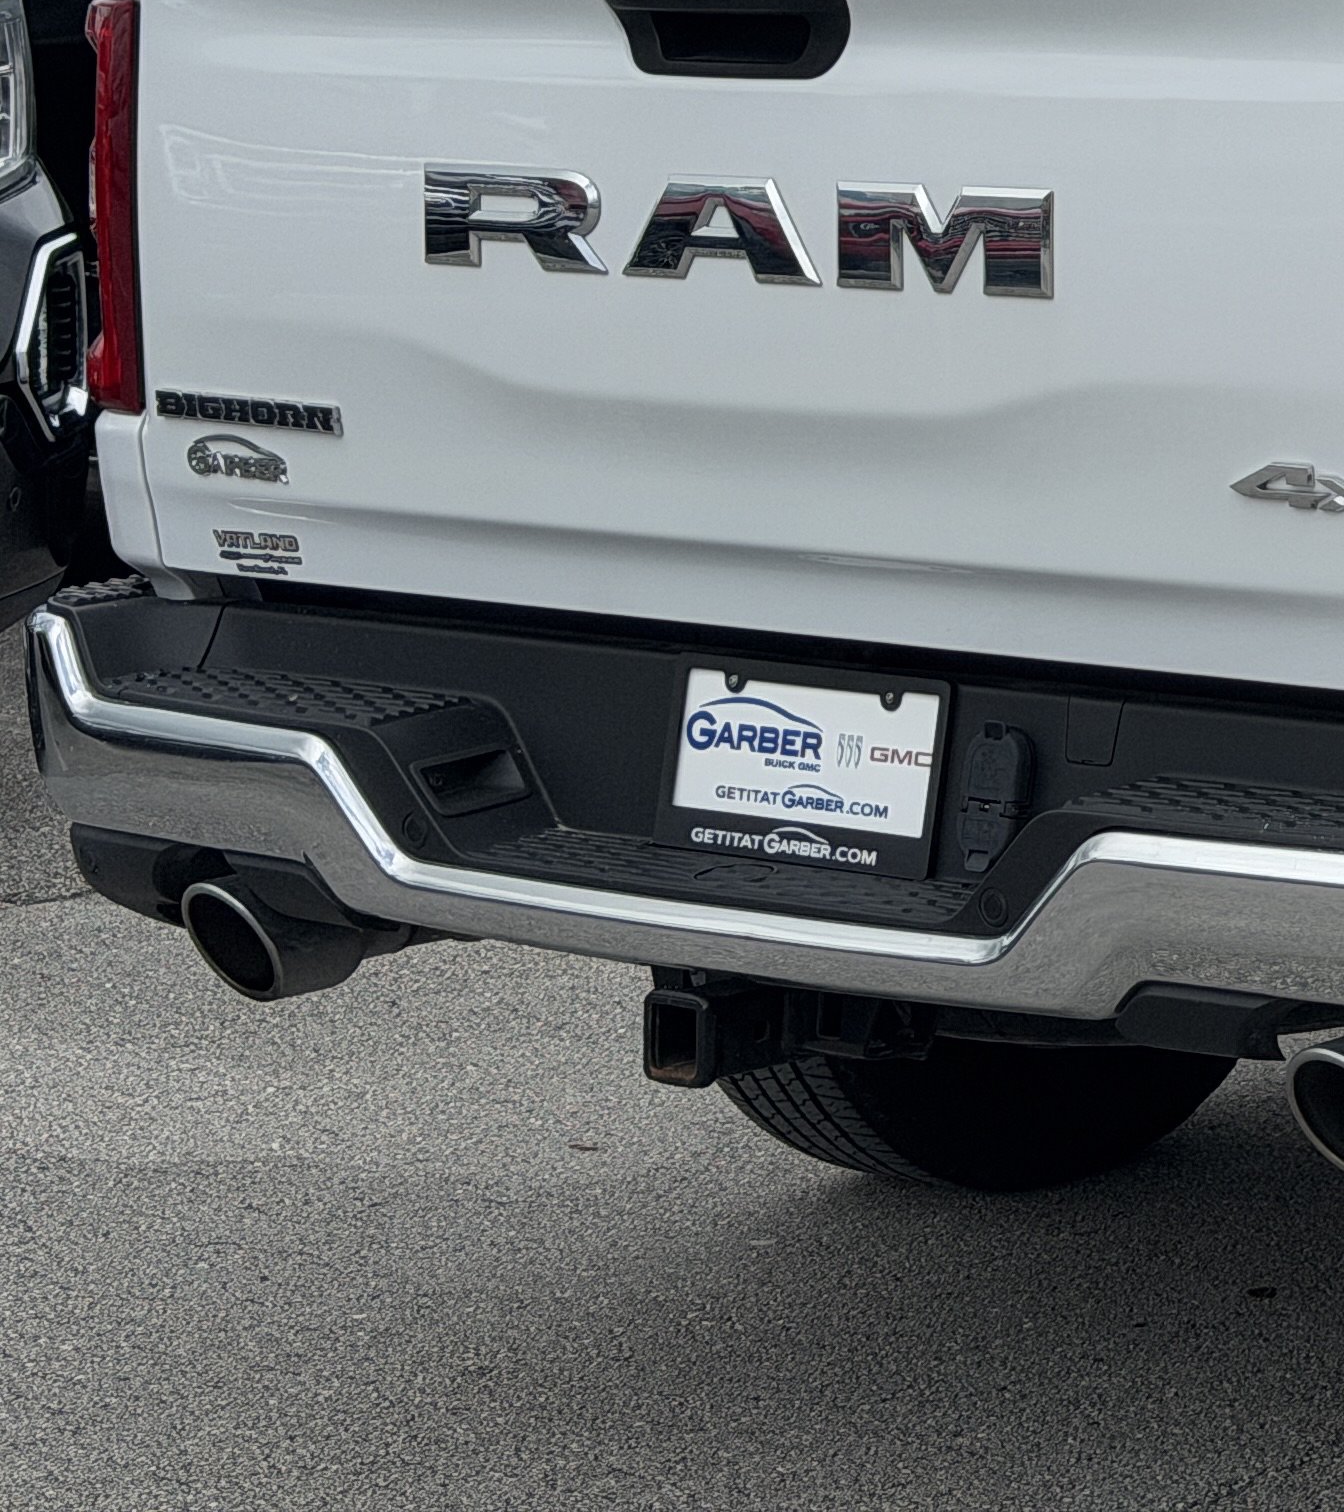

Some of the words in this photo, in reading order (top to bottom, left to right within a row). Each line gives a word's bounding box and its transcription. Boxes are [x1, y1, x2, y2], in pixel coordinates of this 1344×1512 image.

[424, 163, 1054, 298] RAM
[686, 710, 823, 761] GARBER
[764, 757, 796, 770] BUICK
[798, 761, 821, 773] GMC
[870, 746, 933, 767] GMC
[715, 785, 888, 819] GETITATGARBER.COM
[691, 827, 877, 866] GETITATGARBER.COM
